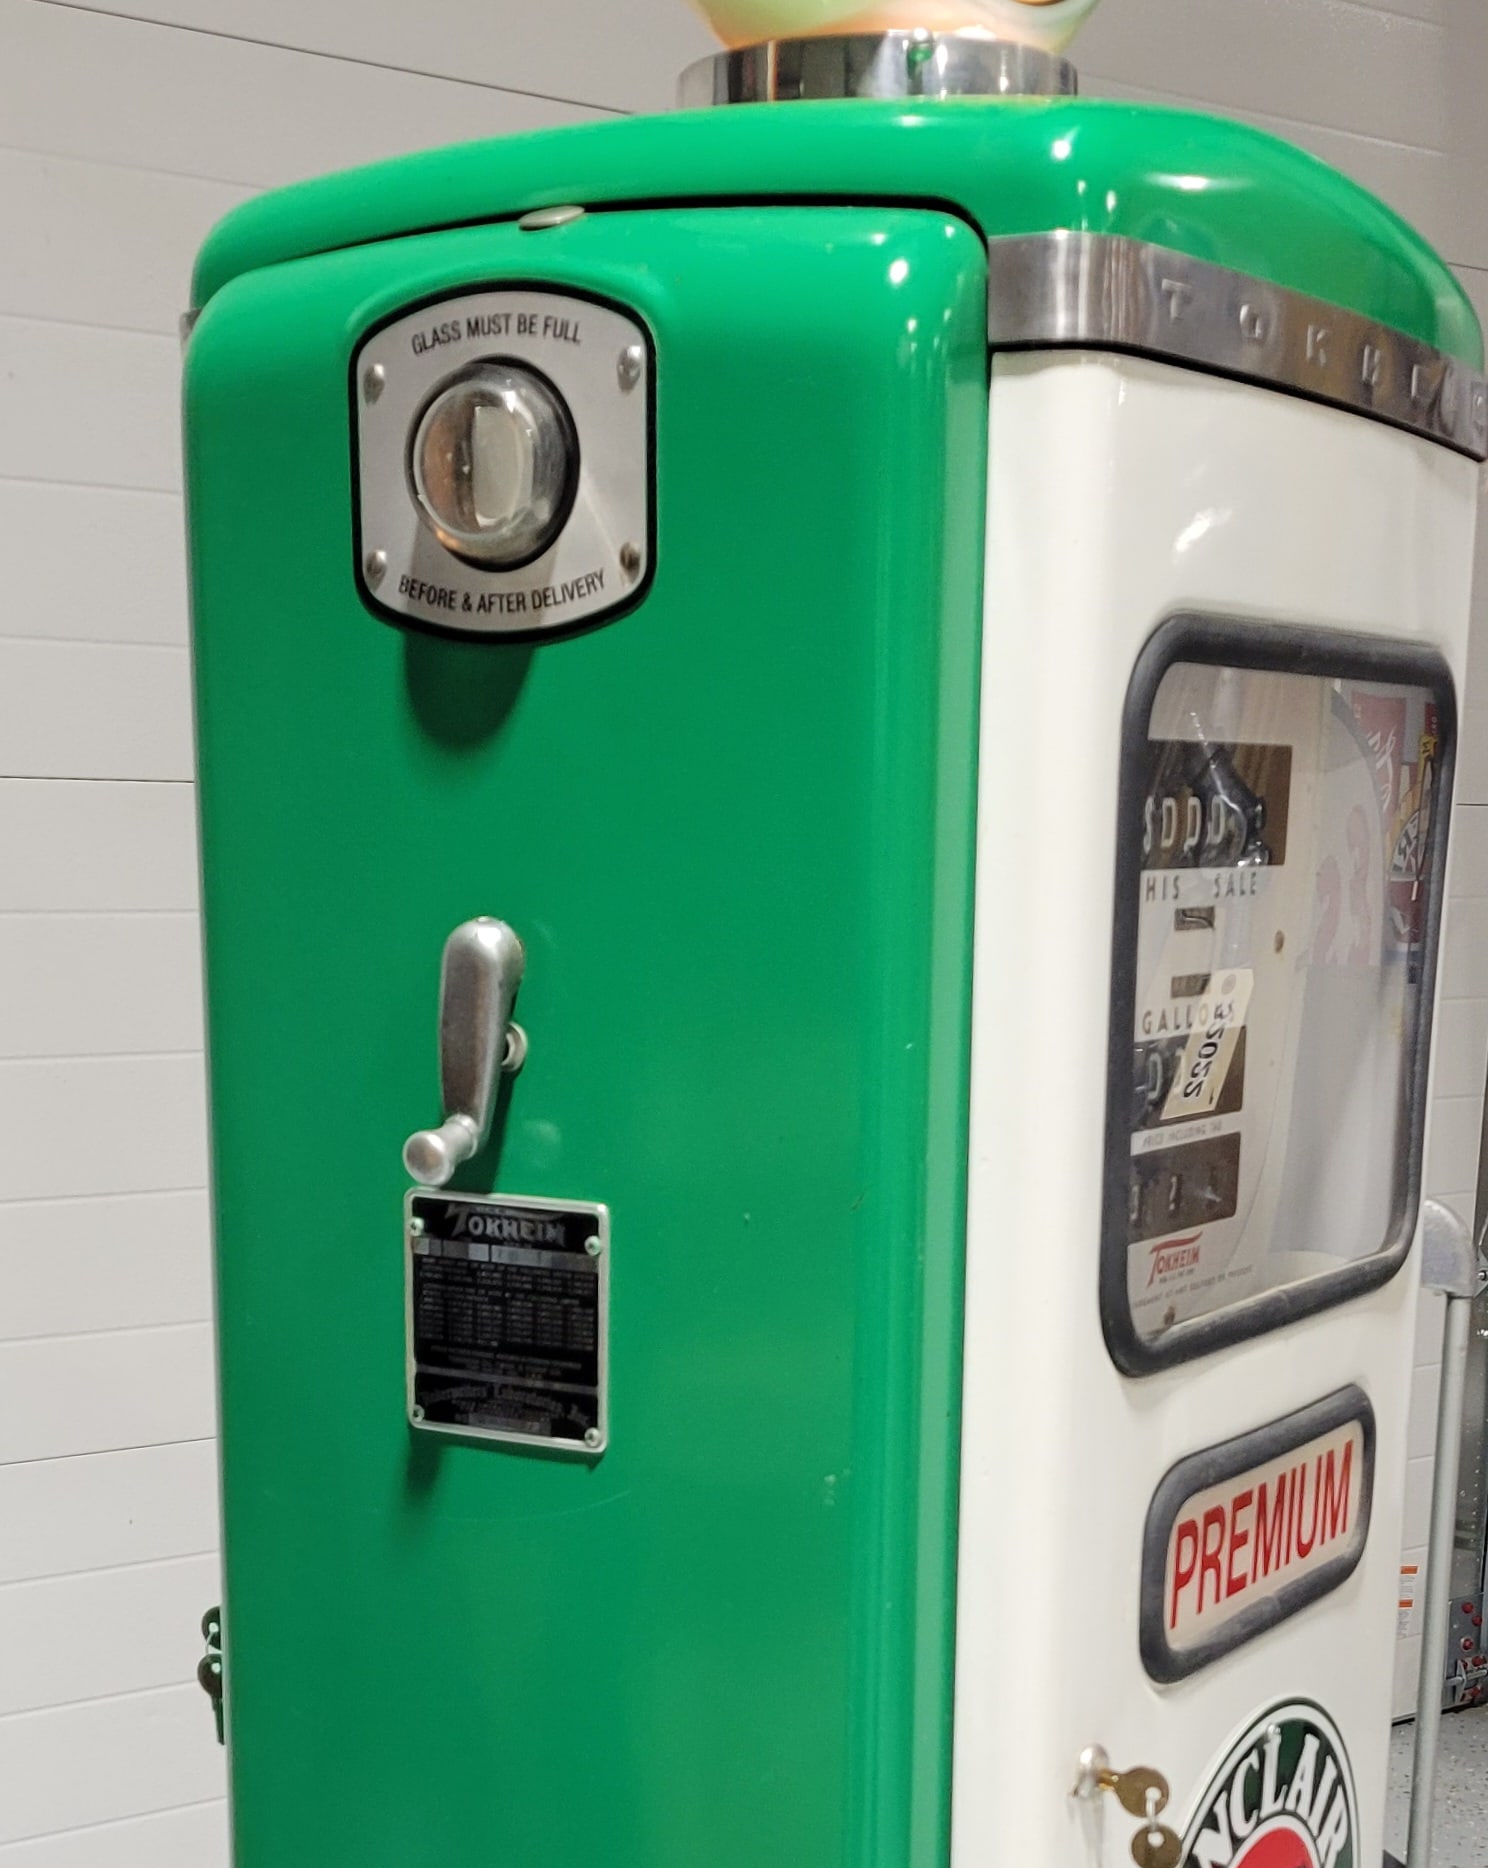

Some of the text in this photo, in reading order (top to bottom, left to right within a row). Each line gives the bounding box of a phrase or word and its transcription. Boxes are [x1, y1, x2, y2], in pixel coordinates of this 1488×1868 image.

[411, 313, 582, 357] GLASS MUST BE FULL
[398, 568, 606, 614] BEFORE & AFTER DELIVERY
[1146, 872, 1257, 902] HIS SALE
[445, 1202, 567, 1248] TOKHEIM
[1146, 1231, 1203, 1288] TOKHEIM
[1169, 1439, 1354, 1629] PREMIUM
